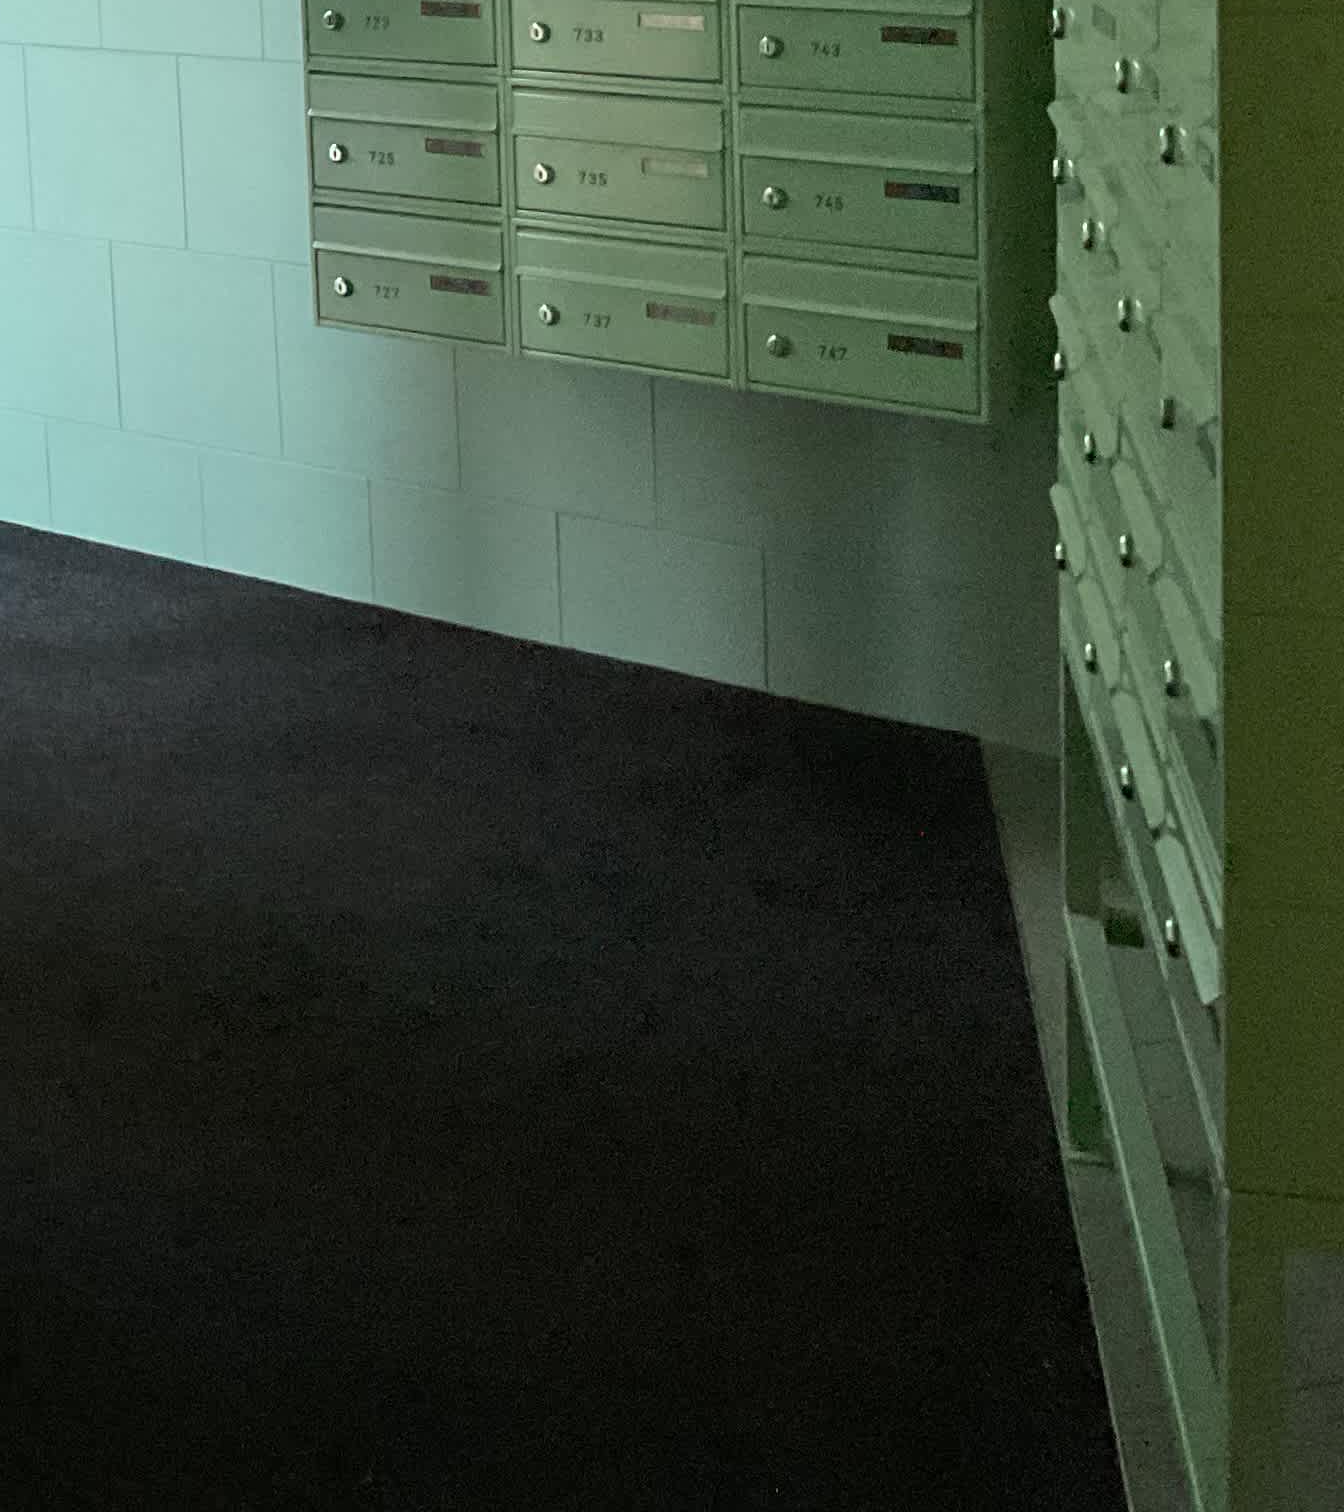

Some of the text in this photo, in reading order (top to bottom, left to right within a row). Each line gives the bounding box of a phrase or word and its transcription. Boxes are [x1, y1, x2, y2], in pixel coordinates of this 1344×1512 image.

[572, 27, 605, 44] 733
[811, 41, 841, 59] 743
[368, 150, 395, 166] 725
[578, 170, 609, 188] 735
[584, 312, 612, 329] 737
[818, 344, 849, 362] 747
